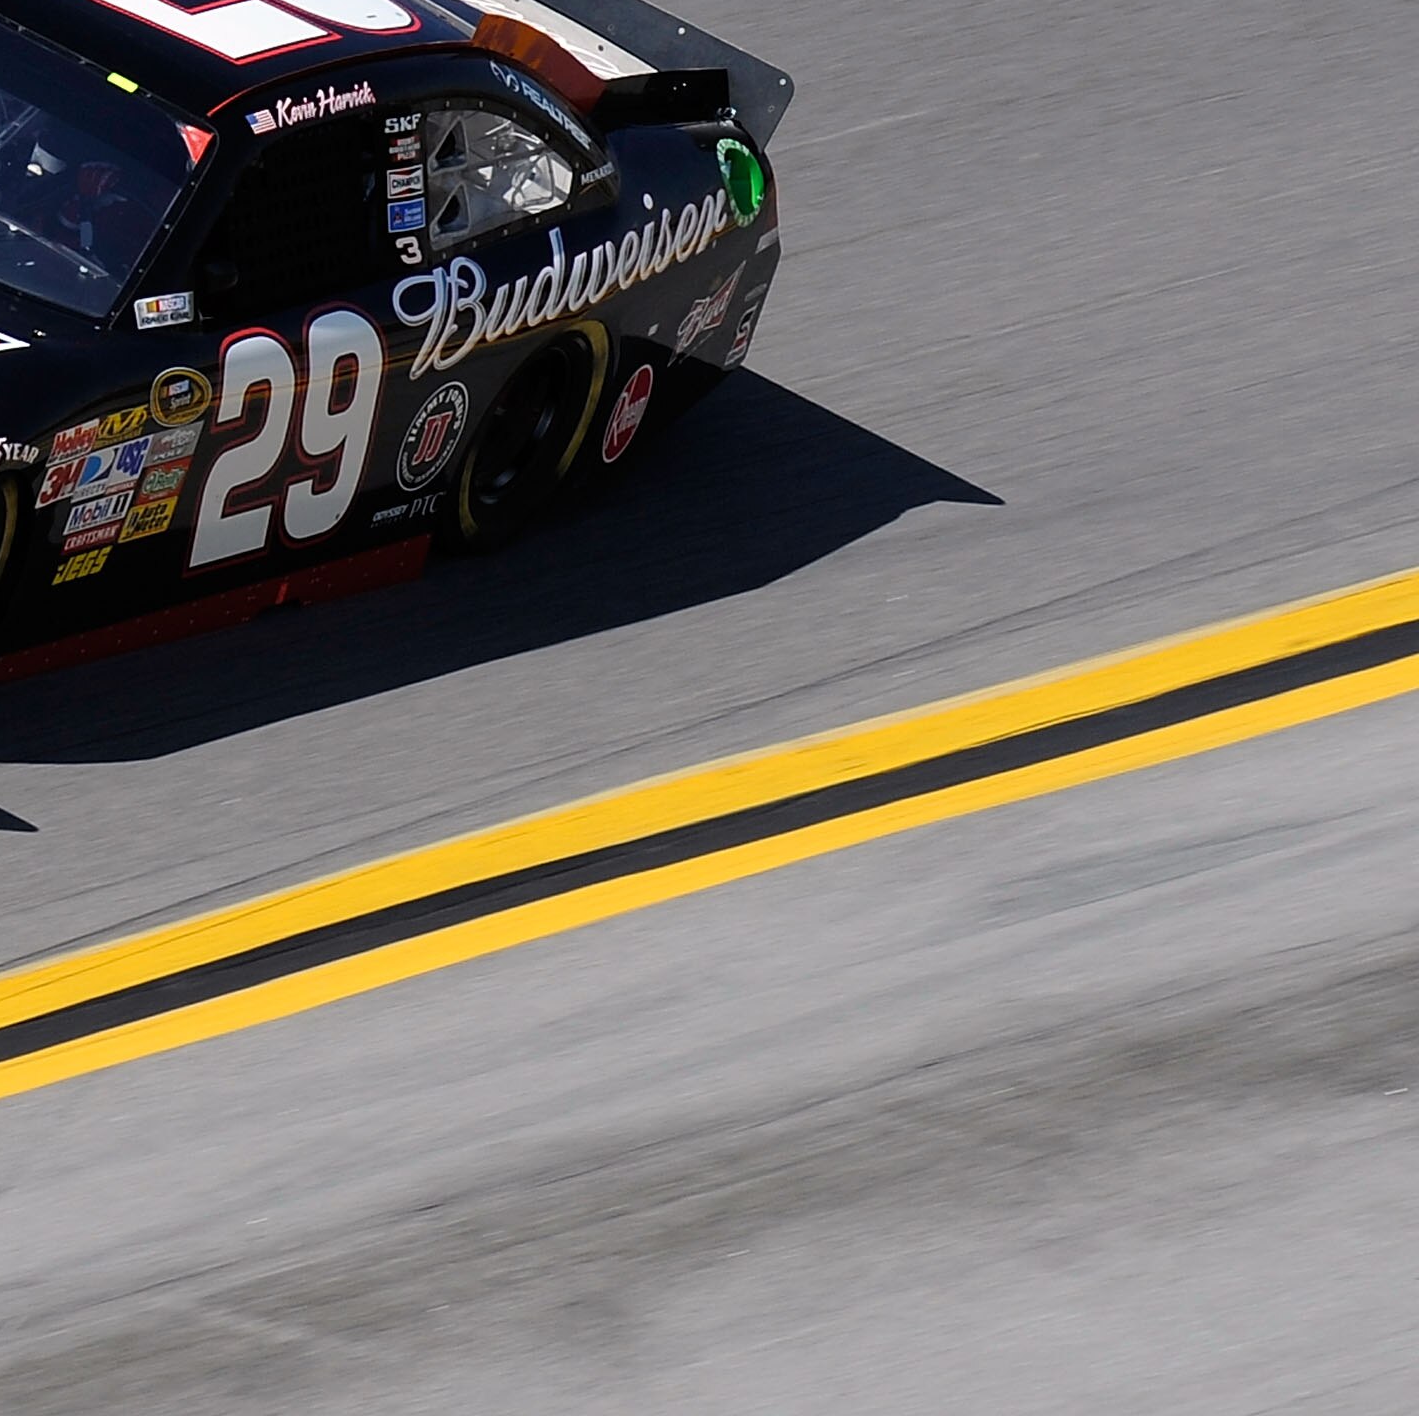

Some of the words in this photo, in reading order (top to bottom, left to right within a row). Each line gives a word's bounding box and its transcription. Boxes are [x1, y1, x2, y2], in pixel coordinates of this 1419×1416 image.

[274, 98, 316, 129] Kevin
[315, 81, 377, 118] Harvick
[384, 113, 422, 133] SKF
[522, 83, 592, 151] REALTREE
[395, 236, 423, 265] 3
[392, 193, 729, 381] Budweiser
[185, 304, 388, 574] 29
[70, 498, 111, 528] Mobil
[111, 491, 129, 515] 1
[64, 523, 119, 552] CRAFTSMAN
[56, 545, 111, 584] JEGS
